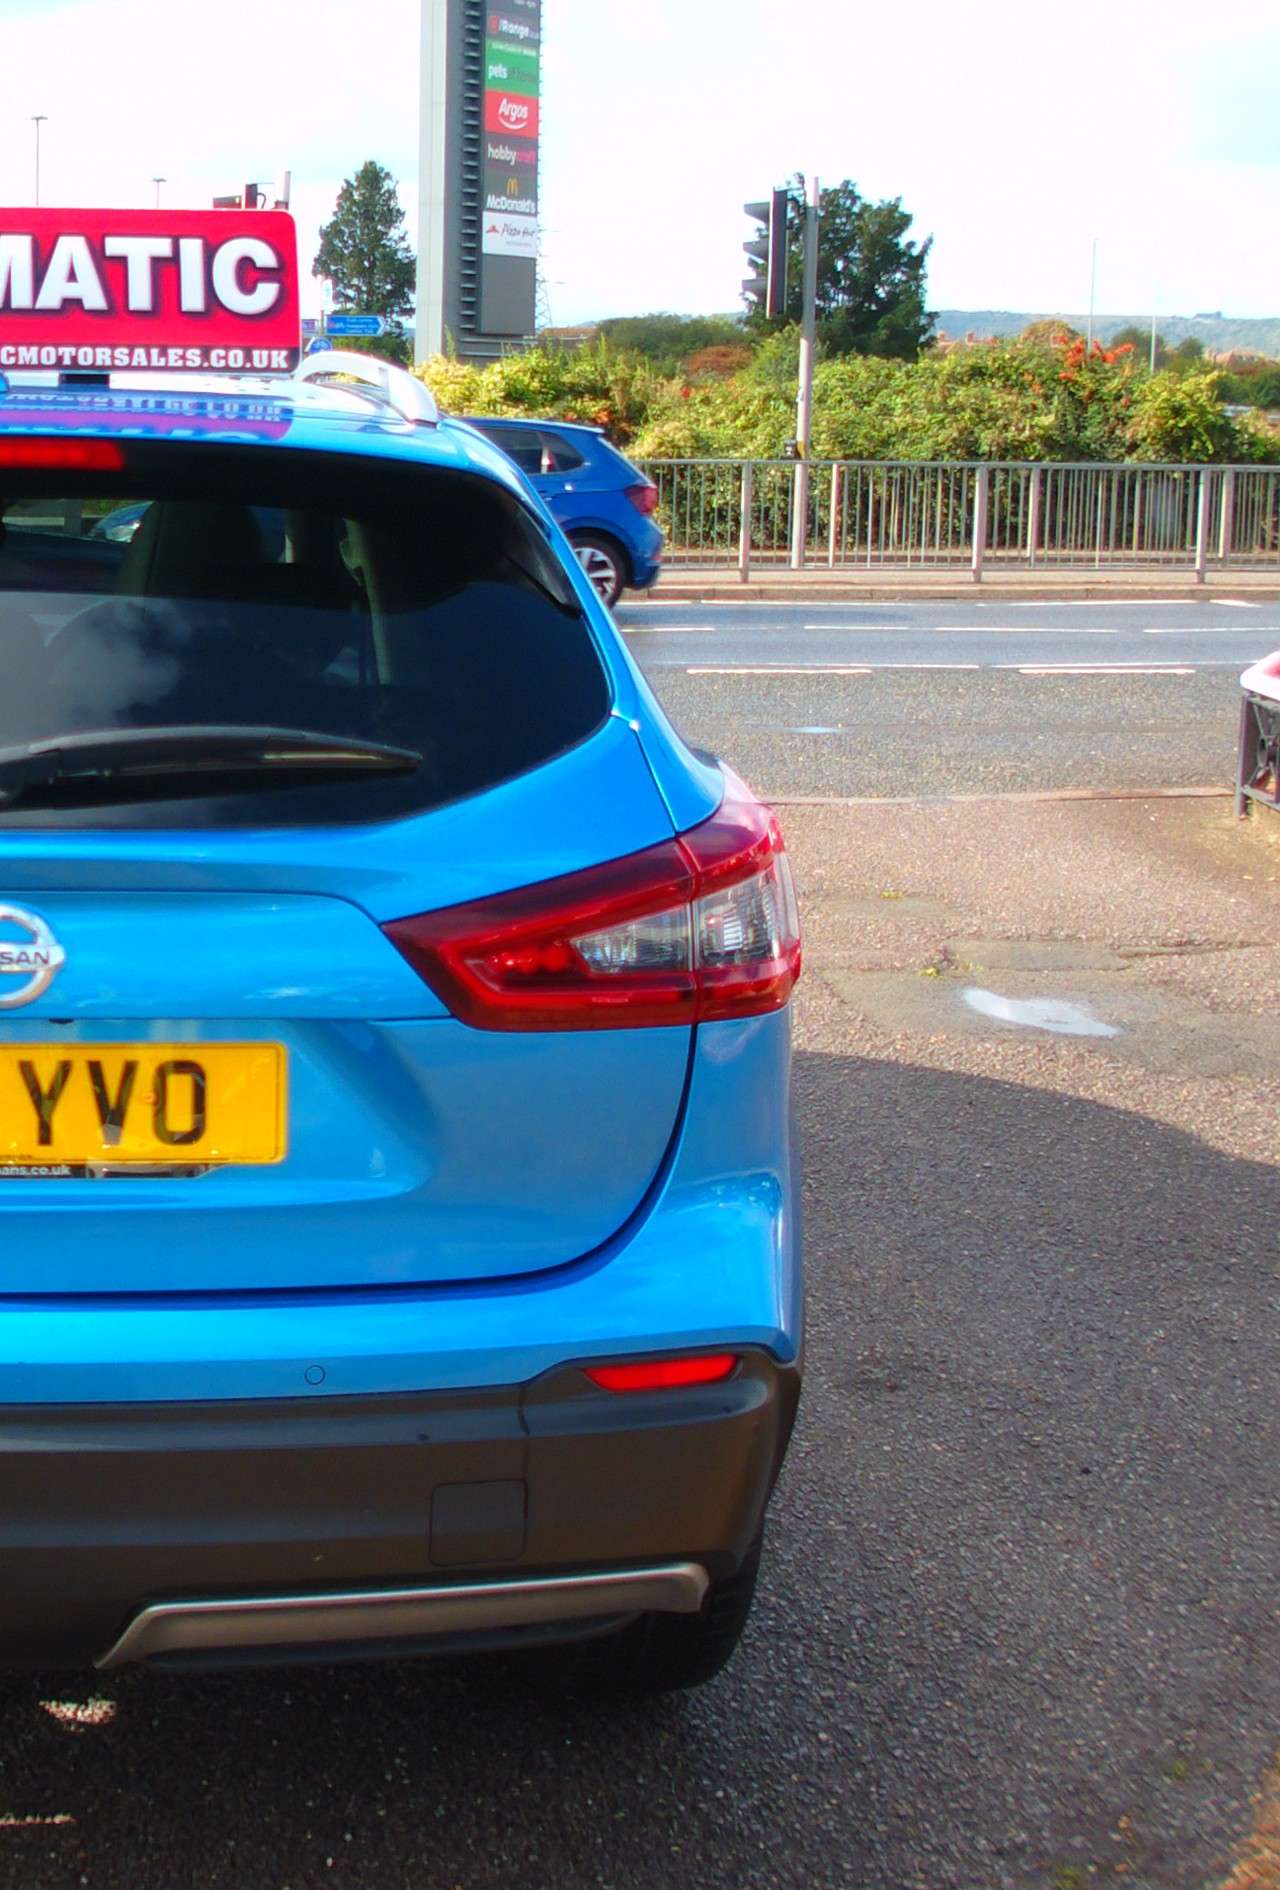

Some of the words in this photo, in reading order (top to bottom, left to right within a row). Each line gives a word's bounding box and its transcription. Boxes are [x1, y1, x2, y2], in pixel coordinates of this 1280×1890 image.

[488, 64, 508, 80] pets
[498, 97, 528, 122] Argos
[486, 193, 536, 214] McDonald's
[18, 1060, 207, 1146] YVO
